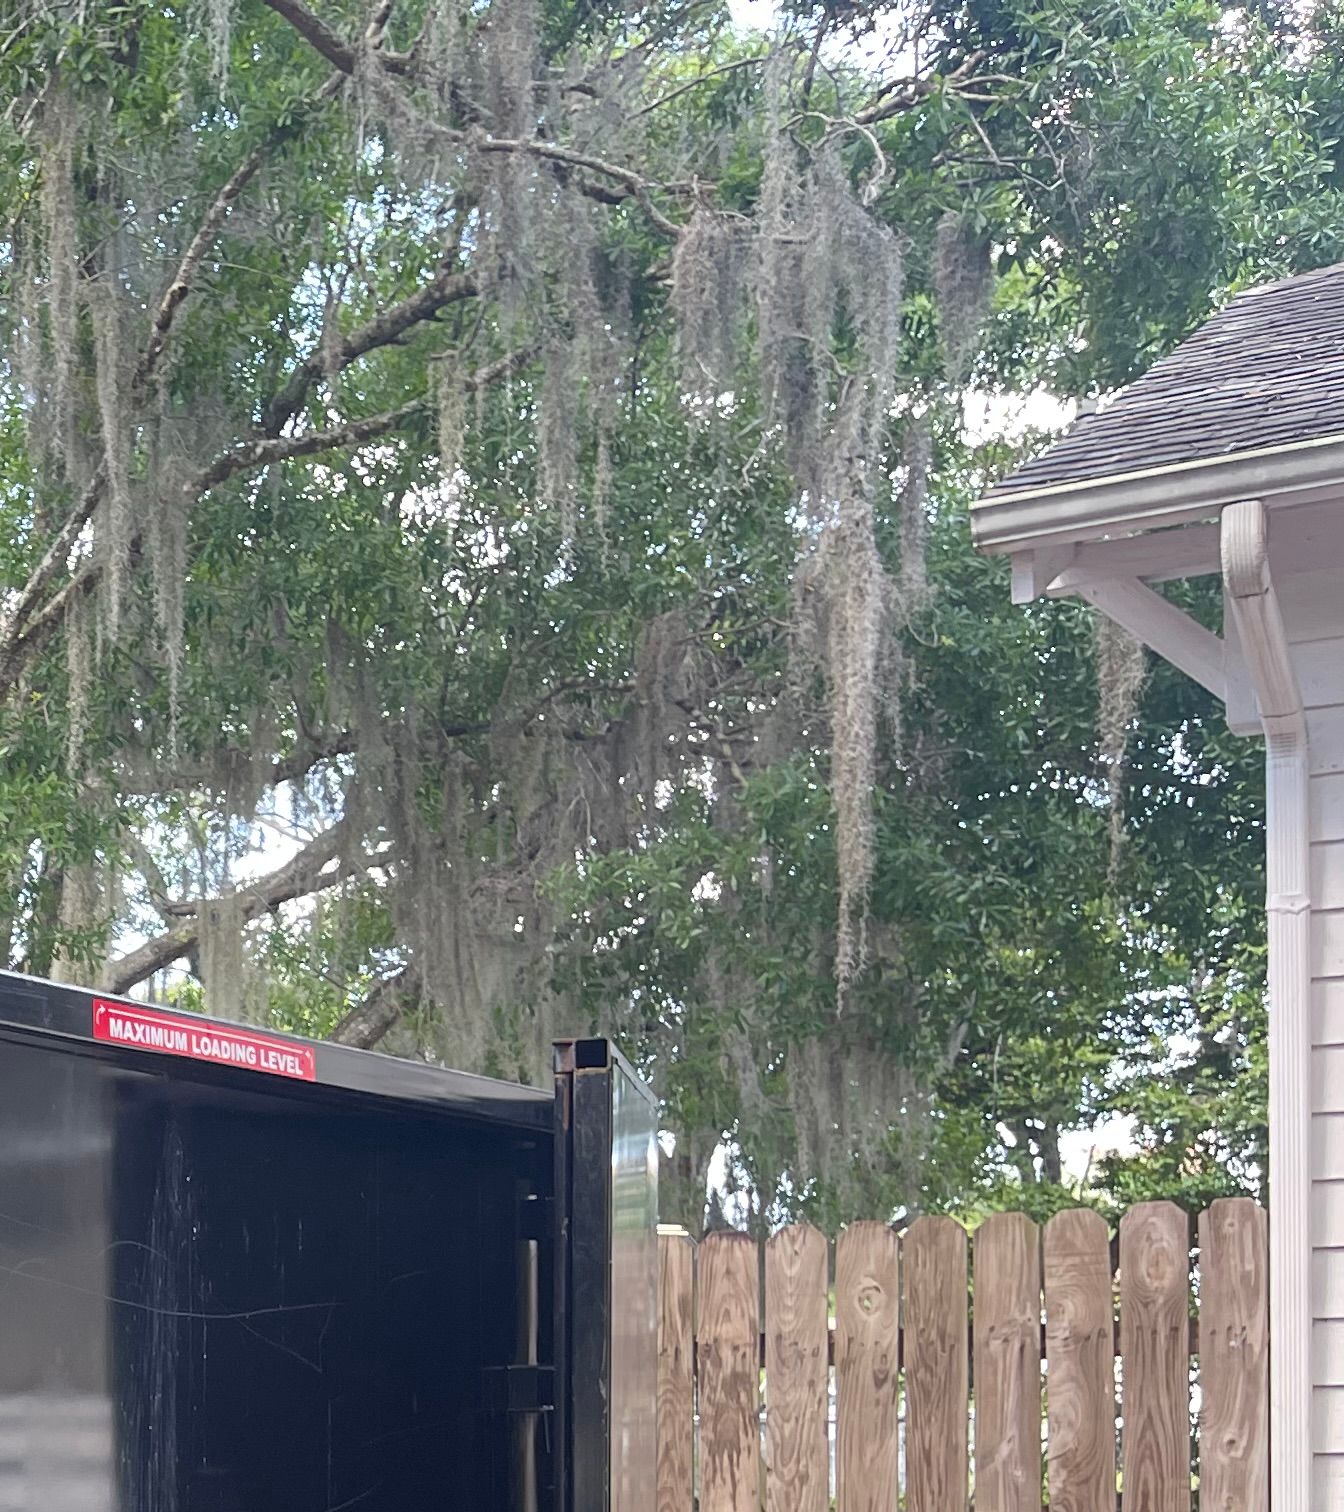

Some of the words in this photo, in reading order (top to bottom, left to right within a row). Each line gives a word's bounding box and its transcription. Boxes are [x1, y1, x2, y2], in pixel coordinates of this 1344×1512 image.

[110, 1018, 187, 1051] MAXIMUM
[192, 1035, 256, 1064] LOADING
[261, 1049, 303, 1075] LEVEL
